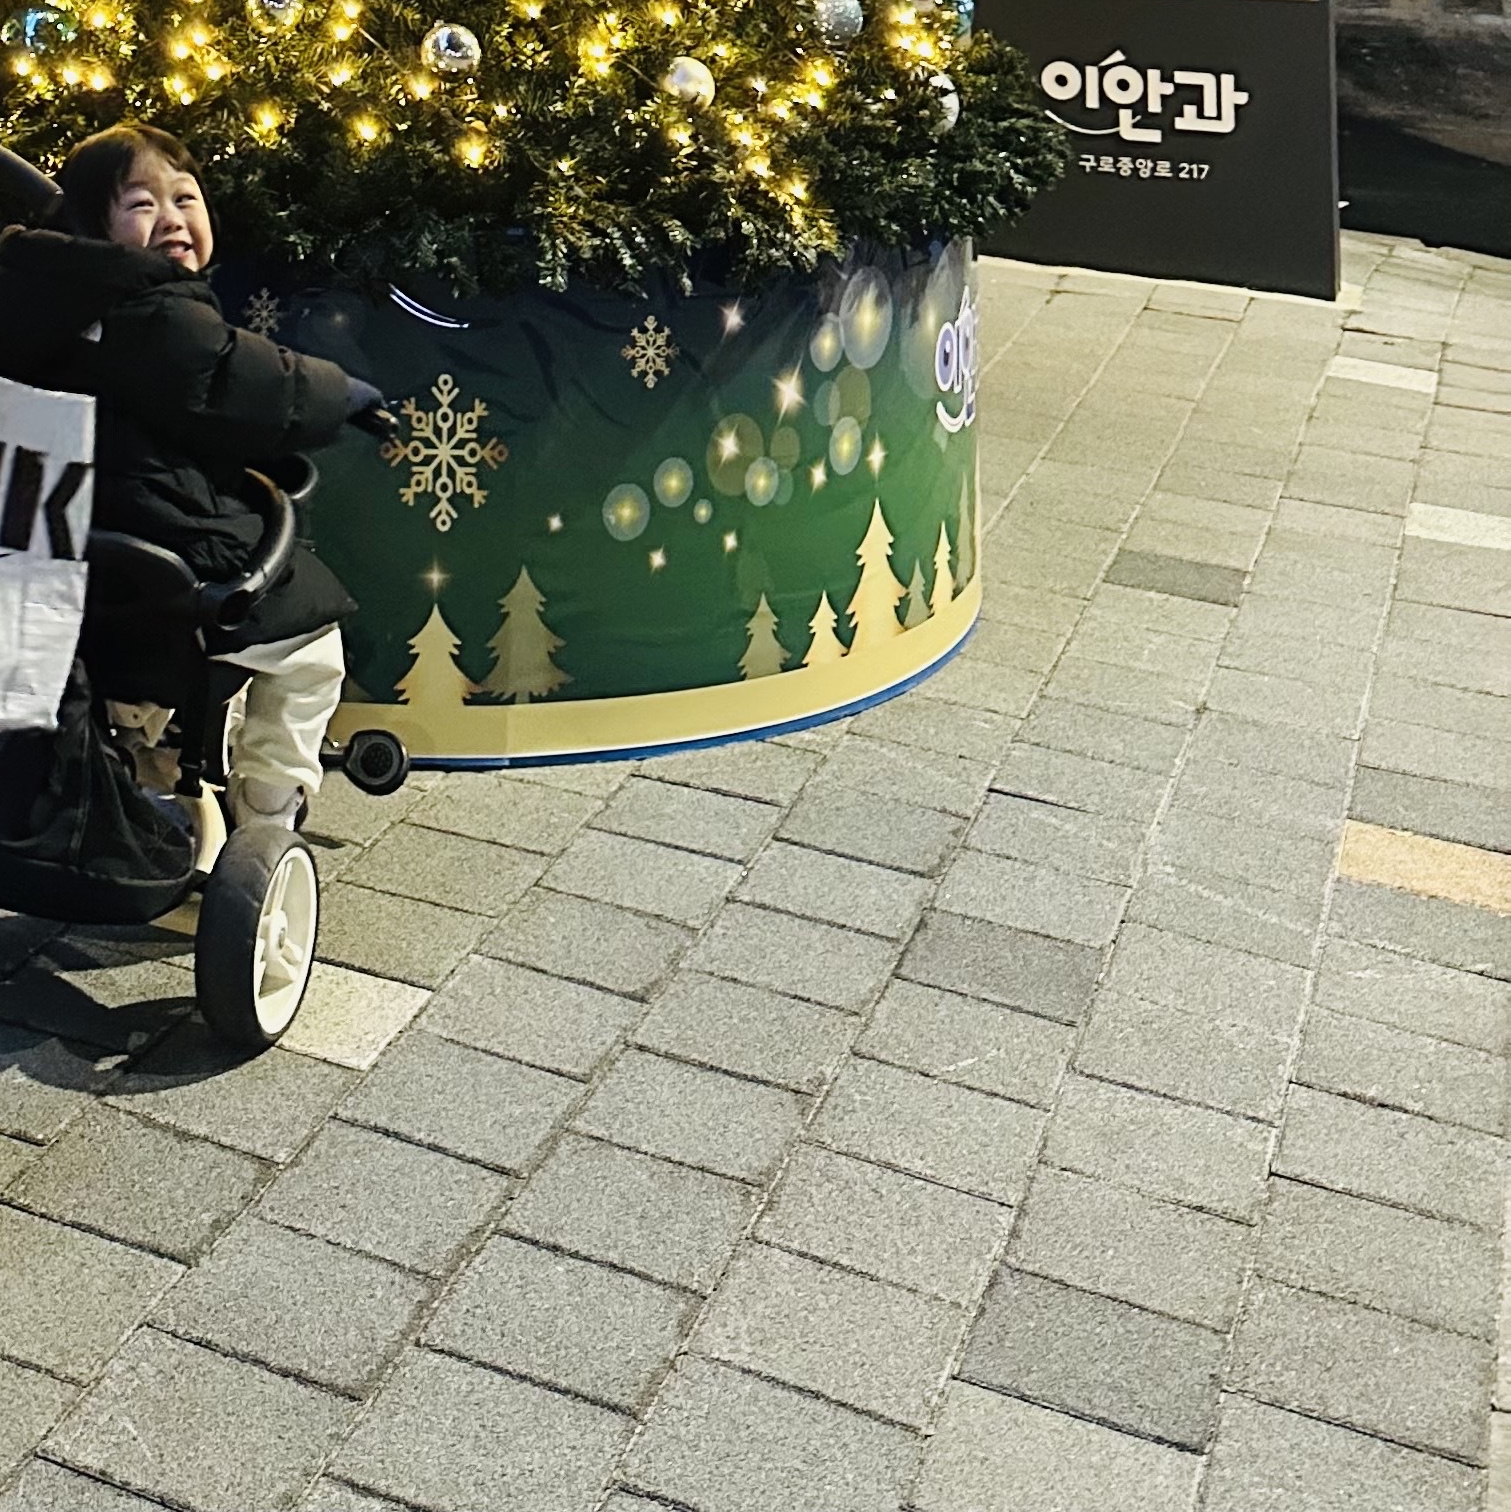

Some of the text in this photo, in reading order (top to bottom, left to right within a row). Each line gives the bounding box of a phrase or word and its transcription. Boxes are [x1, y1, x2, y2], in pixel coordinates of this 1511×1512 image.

[1040, 49, 1250, 144] 이안과
[1078, 154, 1210, 180] 구로중앙로 217
